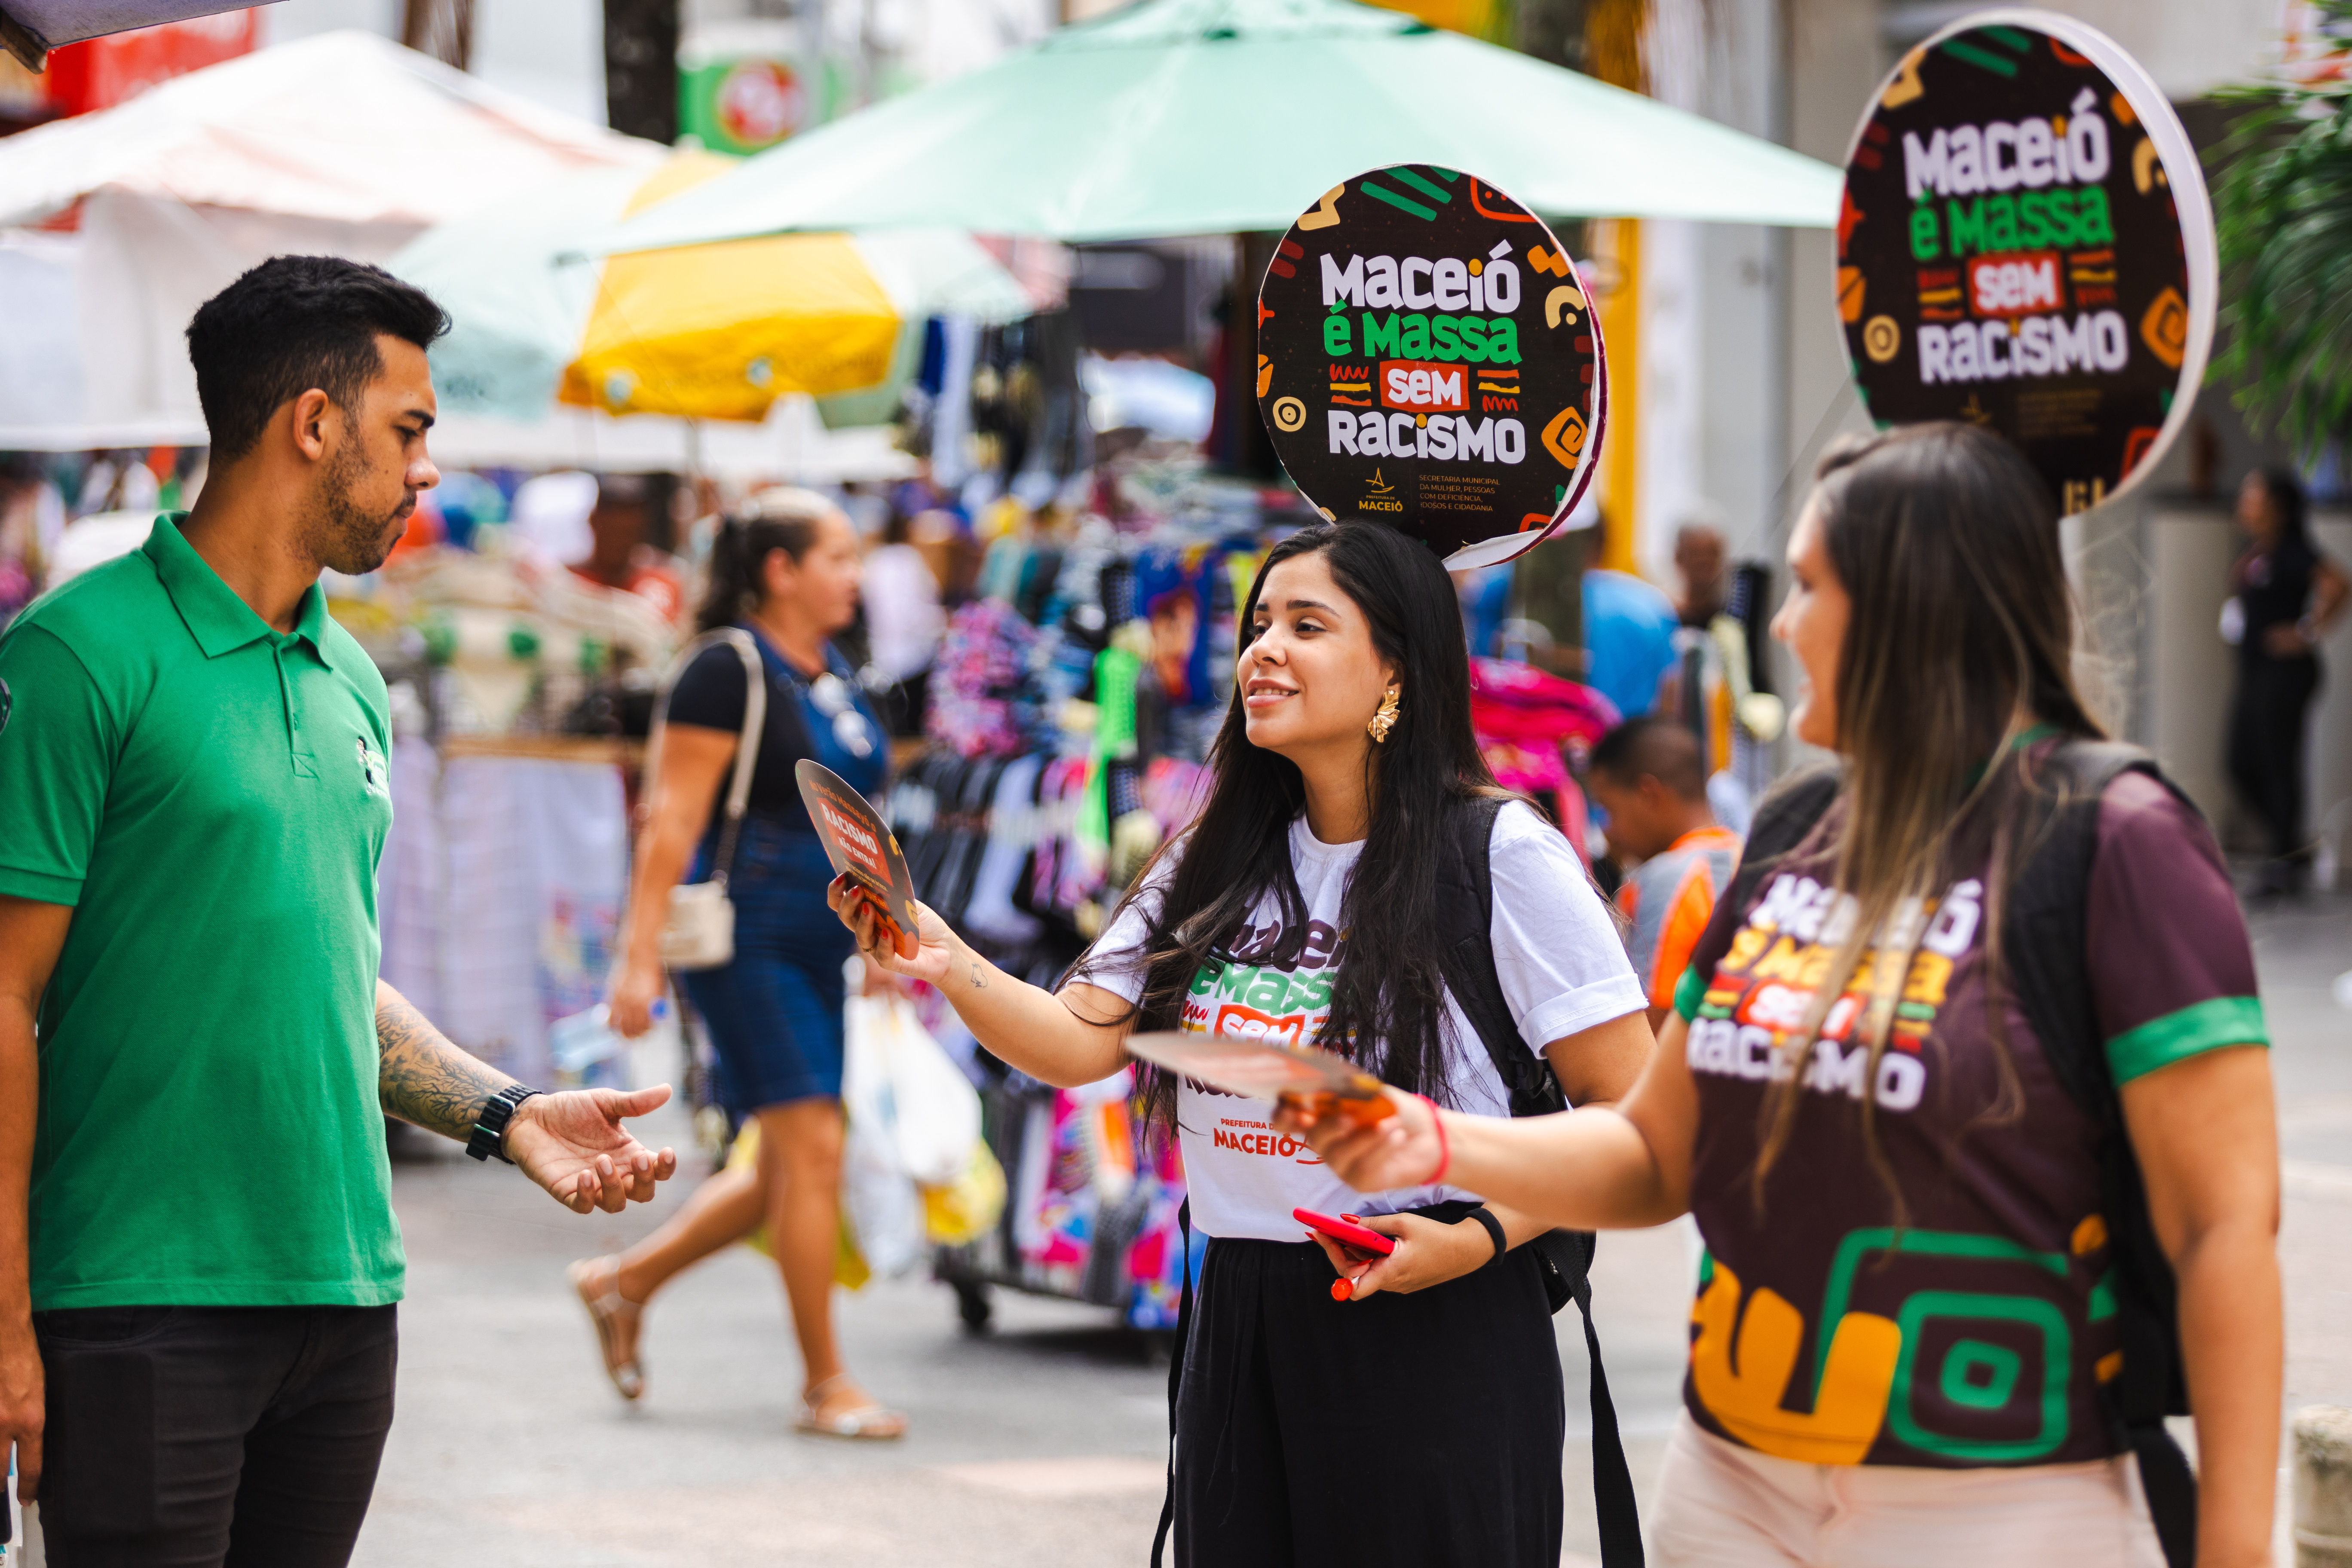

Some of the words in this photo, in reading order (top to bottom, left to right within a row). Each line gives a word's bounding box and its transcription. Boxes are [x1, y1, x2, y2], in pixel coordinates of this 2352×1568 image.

[1431, 484, 1462, 493] MULHER,
[1438, 493, 1483, 503] DEFICIÊNCIA,
[1359, 501, 1403, 511] MACEIÓ
[1454, 503, 1493, 512] CIDADANIA
[817, 782, 837, 802] Verão
[821, 802, 878, 854] RACISMO
[838, 836, 852, 853] NÃO
[851, 846, 877, 870] ENTRA!
[1221, 1118, 1267, 1129] PREFEITURA
[1213, 1127, 1296, 1157] MACEIÓ
